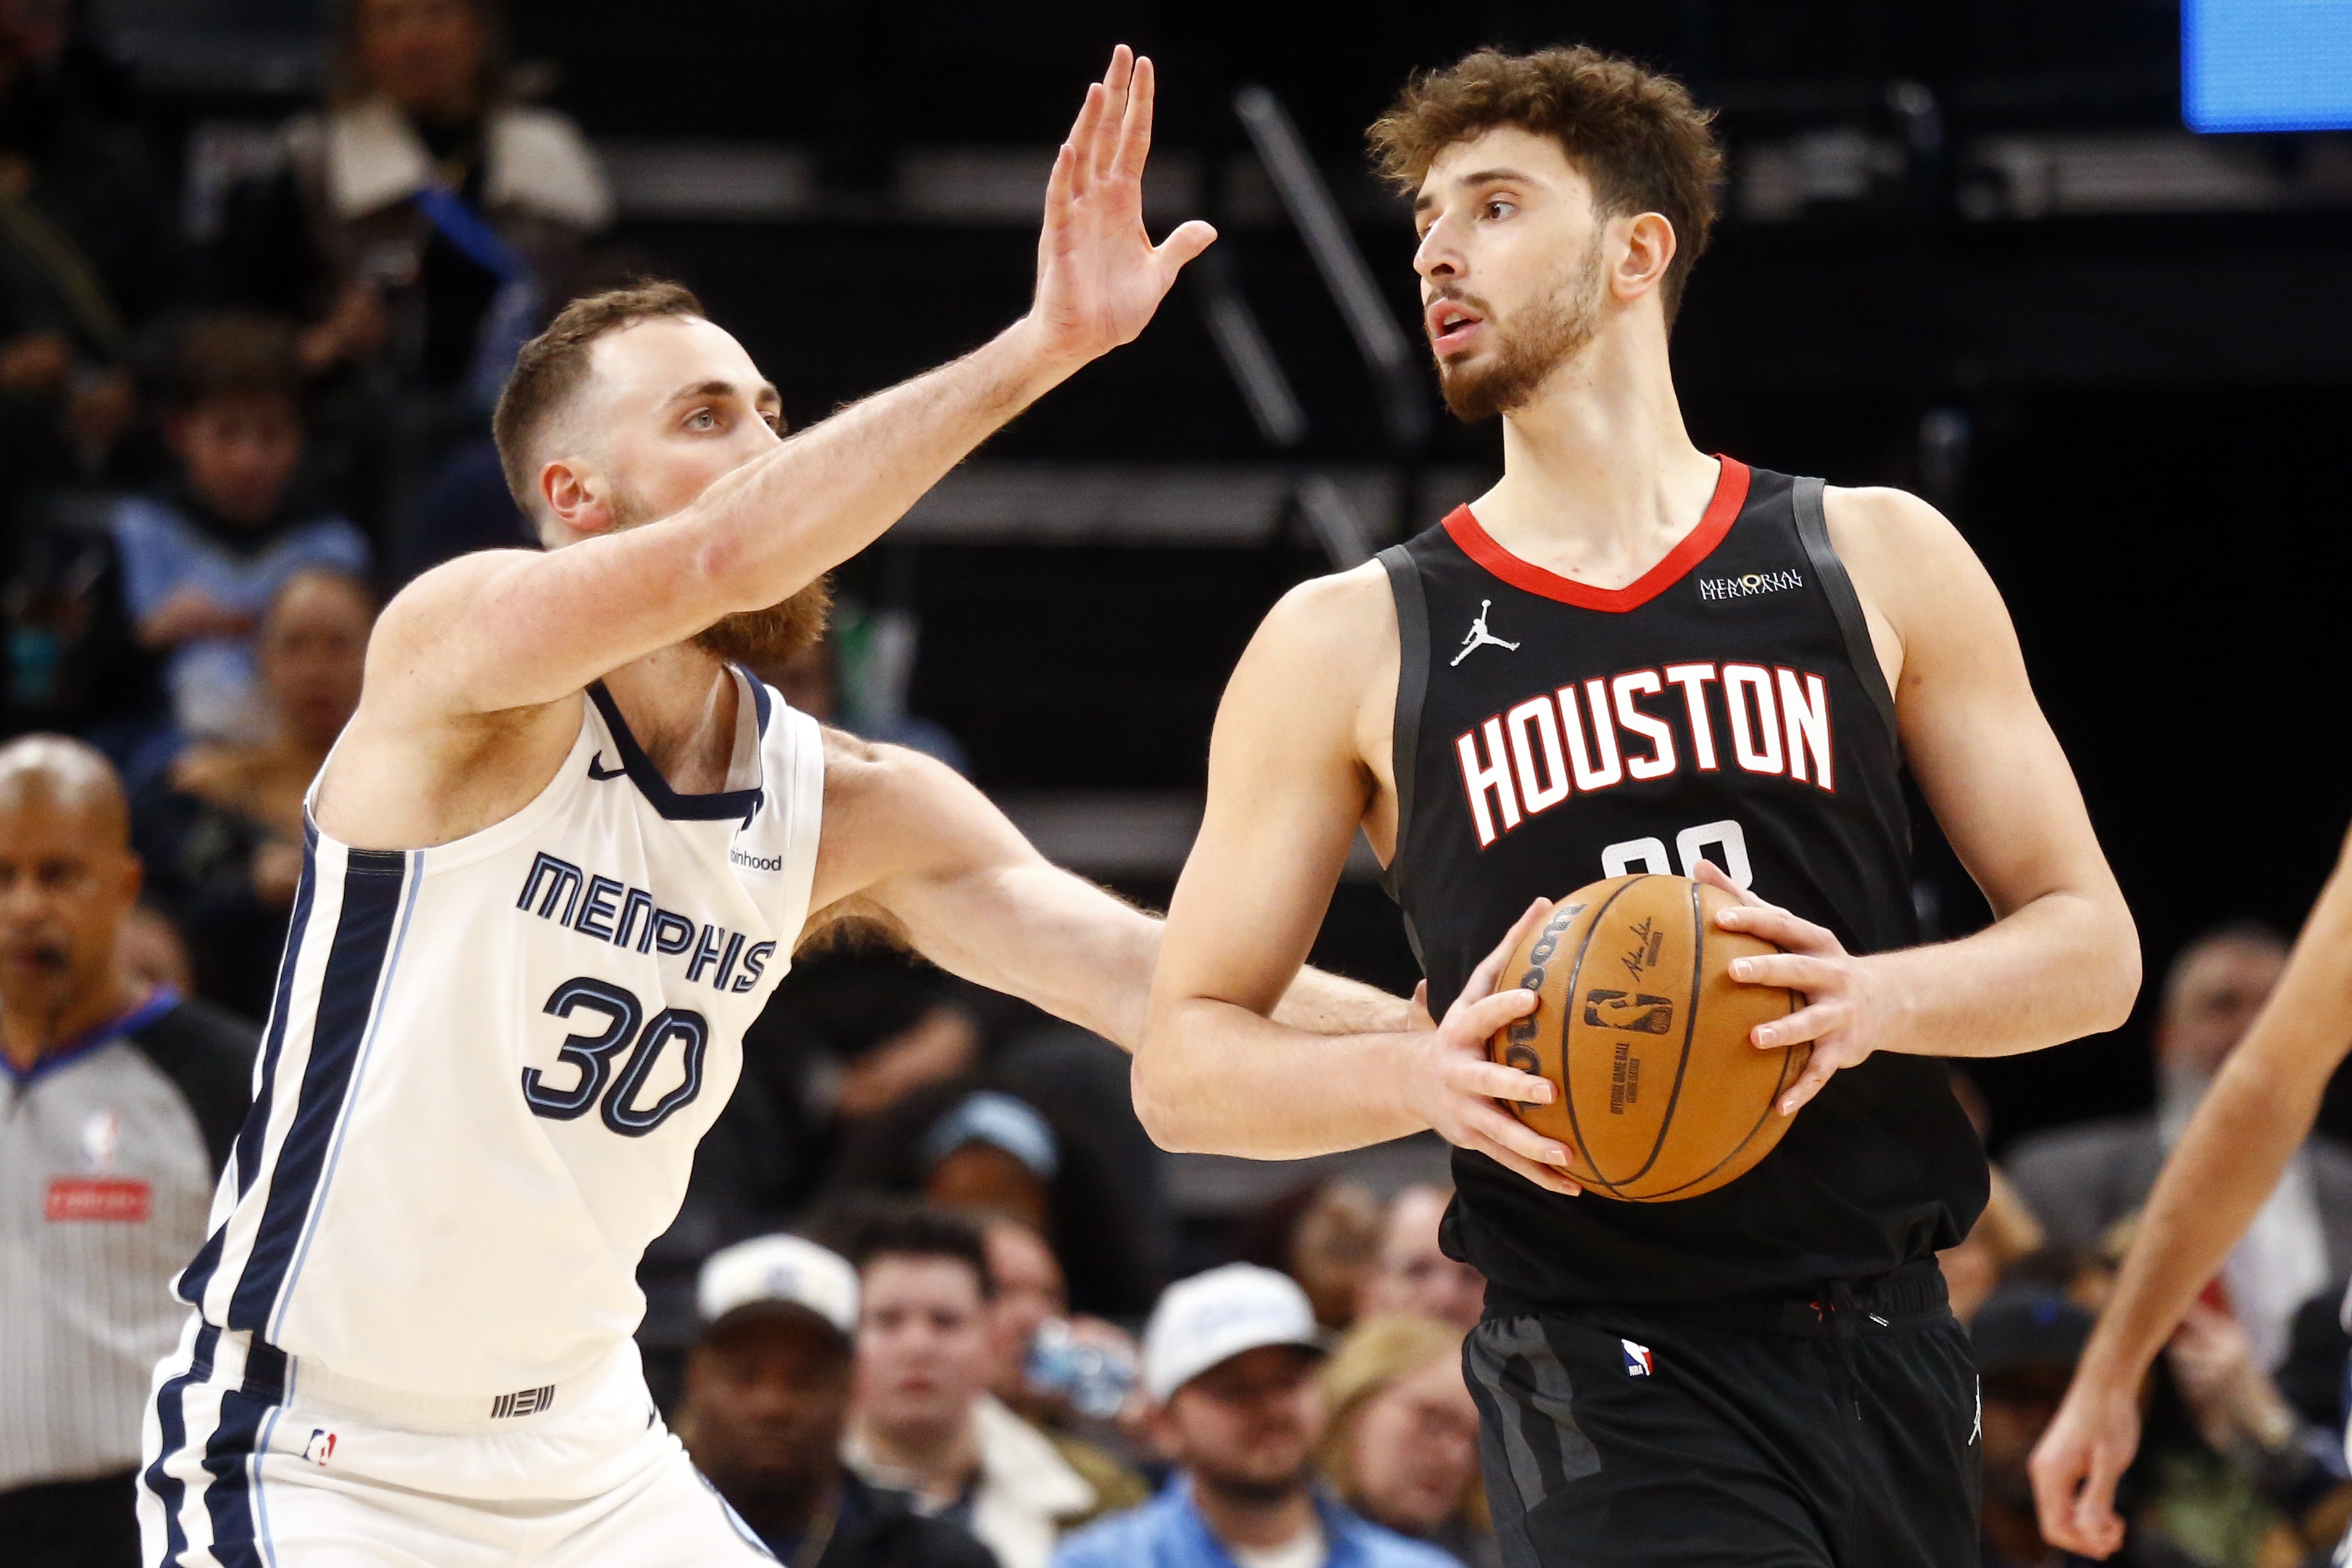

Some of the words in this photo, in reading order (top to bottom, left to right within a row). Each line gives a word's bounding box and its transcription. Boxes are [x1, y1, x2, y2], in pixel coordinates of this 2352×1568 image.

[1700, 569, 1802, 590] MEMORIAL
[1701, 576, 1804, 601] HERMANN
[1455, 661, 1835, 851] HOUSTON
[521, 976, 709, 1138] 30
[1628, 1364, 1644, 1377] NBA
